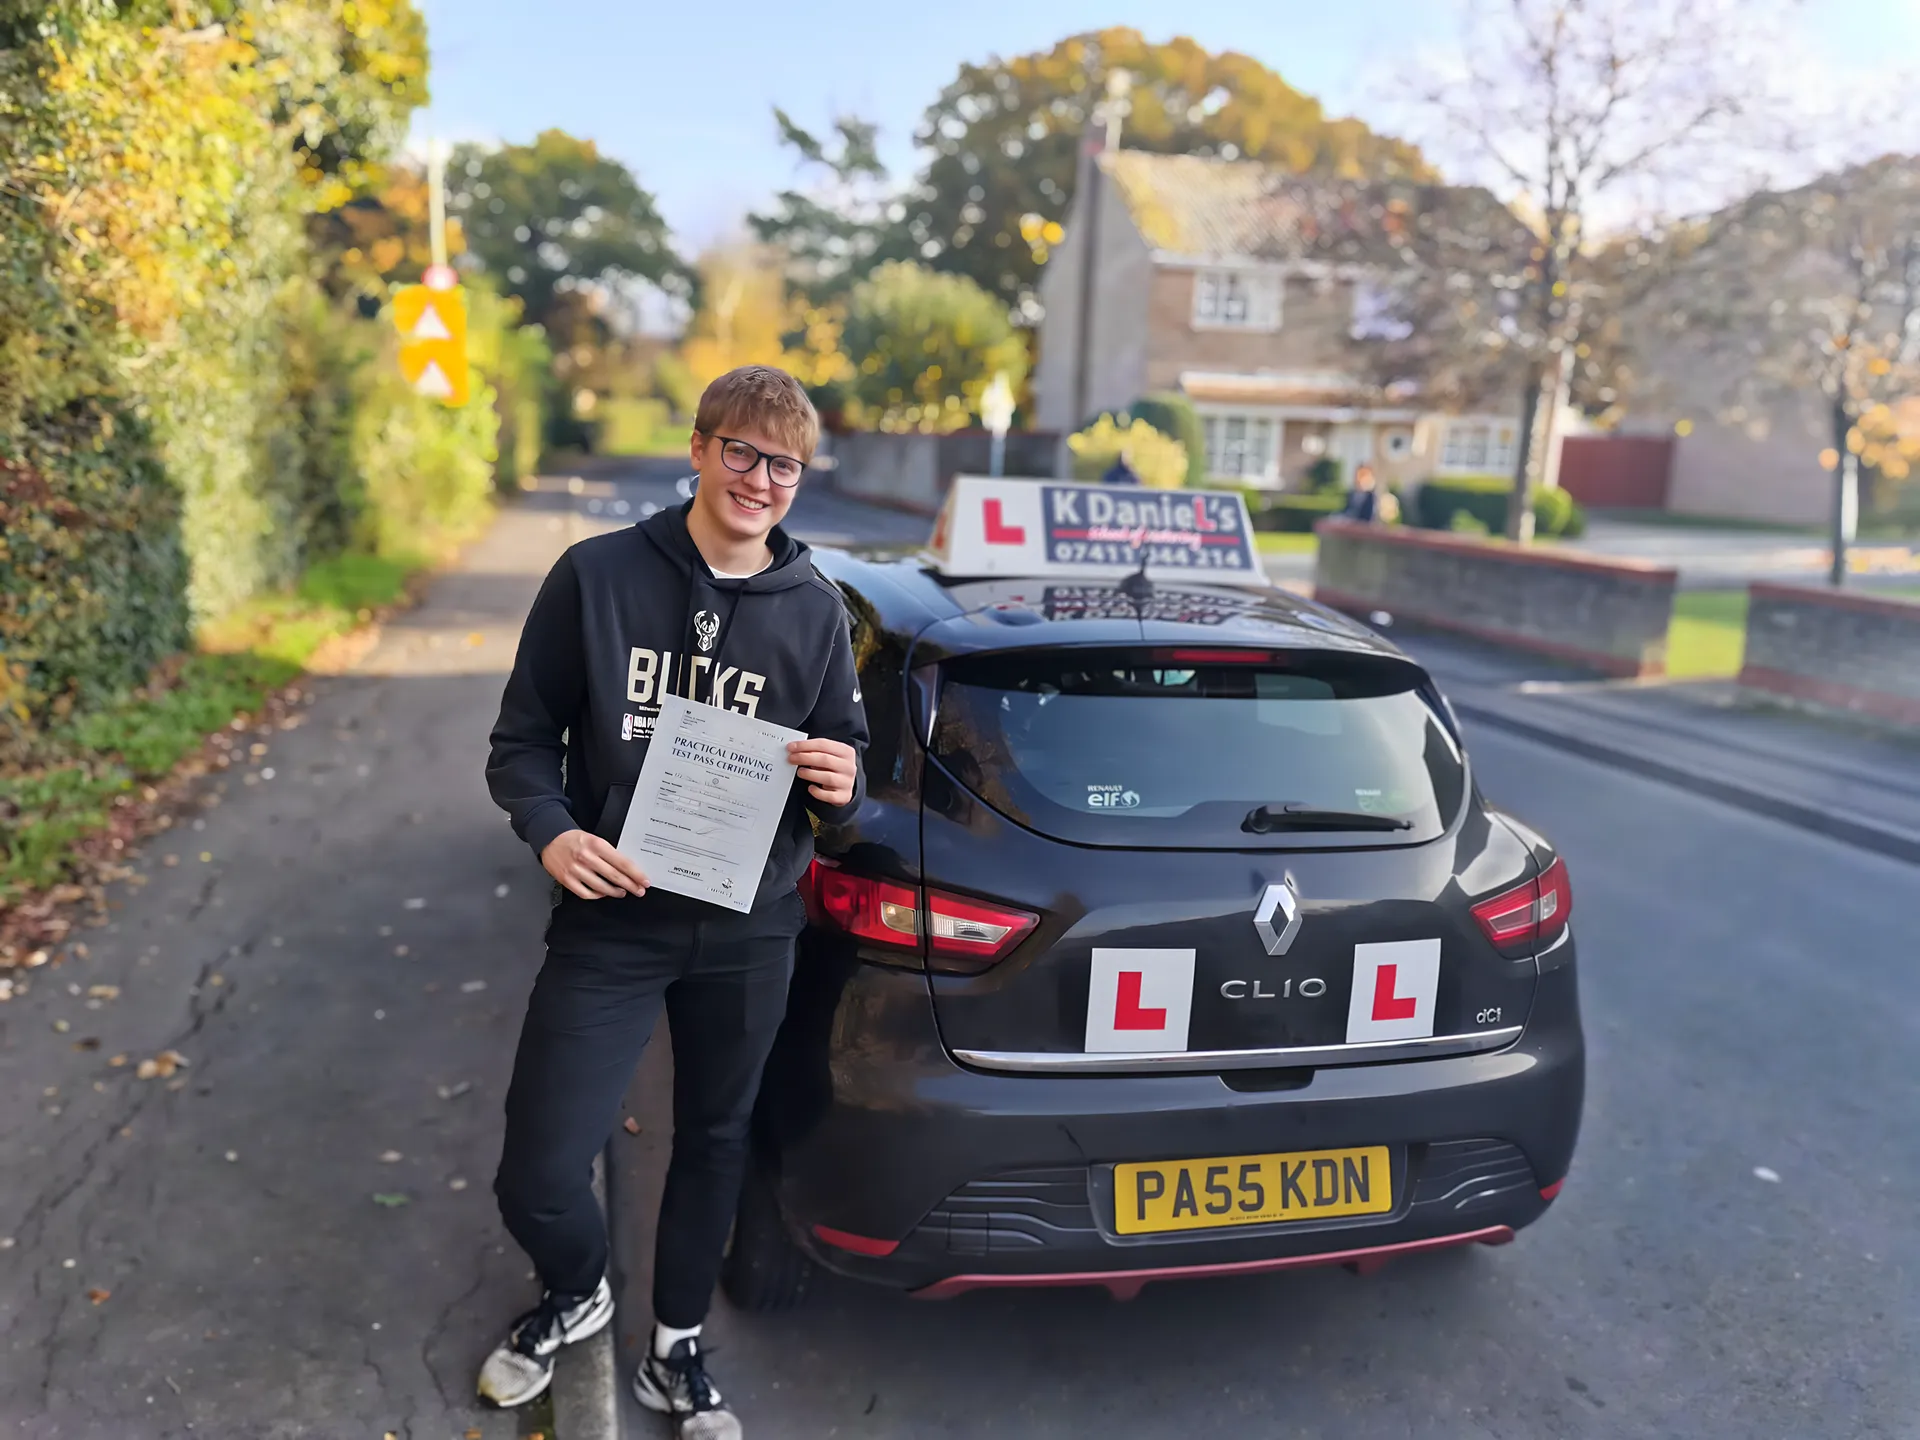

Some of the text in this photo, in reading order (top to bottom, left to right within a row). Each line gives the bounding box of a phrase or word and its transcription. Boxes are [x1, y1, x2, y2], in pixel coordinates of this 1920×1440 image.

[982, 498, 1025, 545] L
[1052, 490, 1237, 531] K DanieL's
[1055, 542, 1134, 562] 07411
[1196, 549, 1241, 567] 214
[634, 716, 647, 728] NBA
[671, 748, 691, 759] TEST
[693, 753, 714, 766] PASS
[716, 760, 770, 782] CERTIFICATE
[674, 736, 773, 772] PRACTICAL DRIVING
[1088, 792, 1120, 806] elf
[1113, 971, 1167, 1031] L
[1220, 978, 1327, 999] CLIO
[1371, 964, 1417, 1021] L
[1136, 1155, 1370, 1220] PA55 KDN
